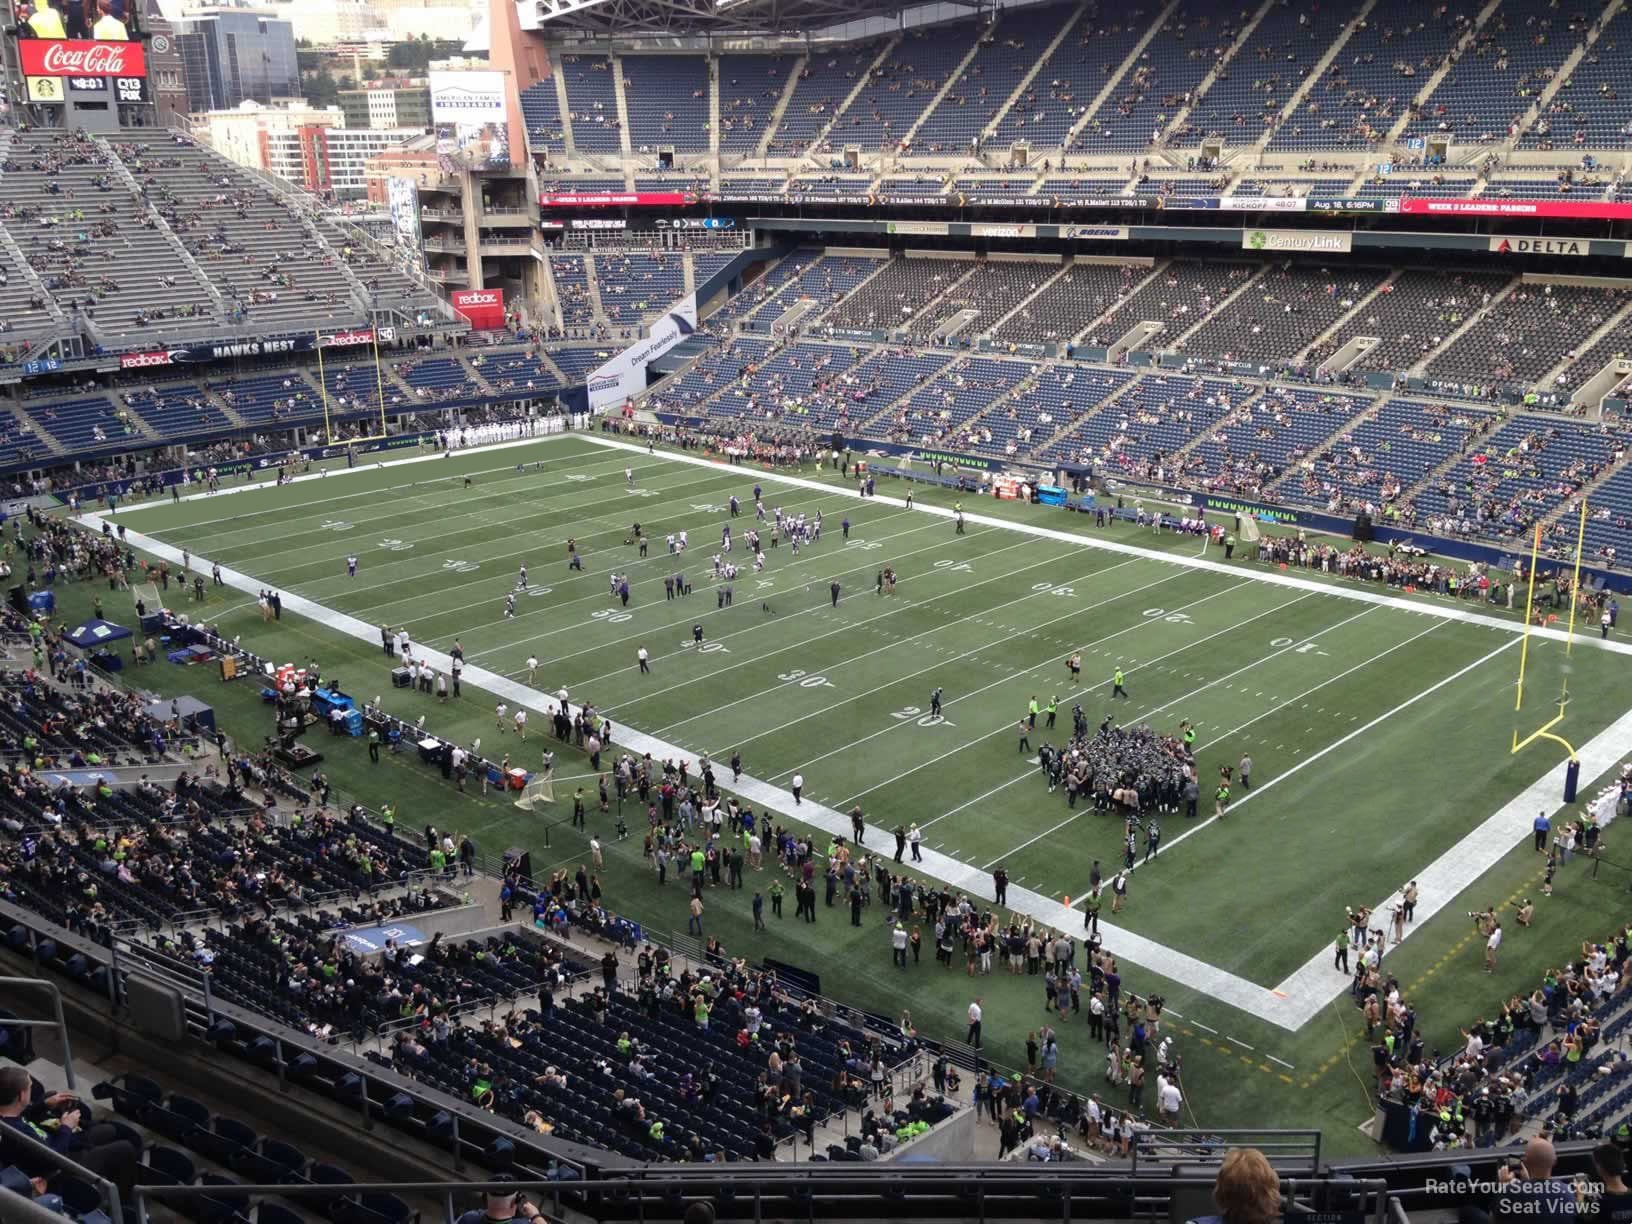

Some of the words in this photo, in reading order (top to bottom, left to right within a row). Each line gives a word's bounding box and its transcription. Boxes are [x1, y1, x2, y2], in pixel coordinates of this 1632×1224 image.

[120, 90, 141, 100] FOX
[1412, 140, 1421, 149] 12
[1380, 164, 1390, 174] 12
[1232, 201, 1267, 209] KICKOFF
[1268, 234, 1343, 251] CenturyLink
[1518, 239, 1581, 255] DELTA
[213, 342, 260, 358] HAWKS
[263, 340, 296, 353] NEST
[777, 669, 828, 688] 30
